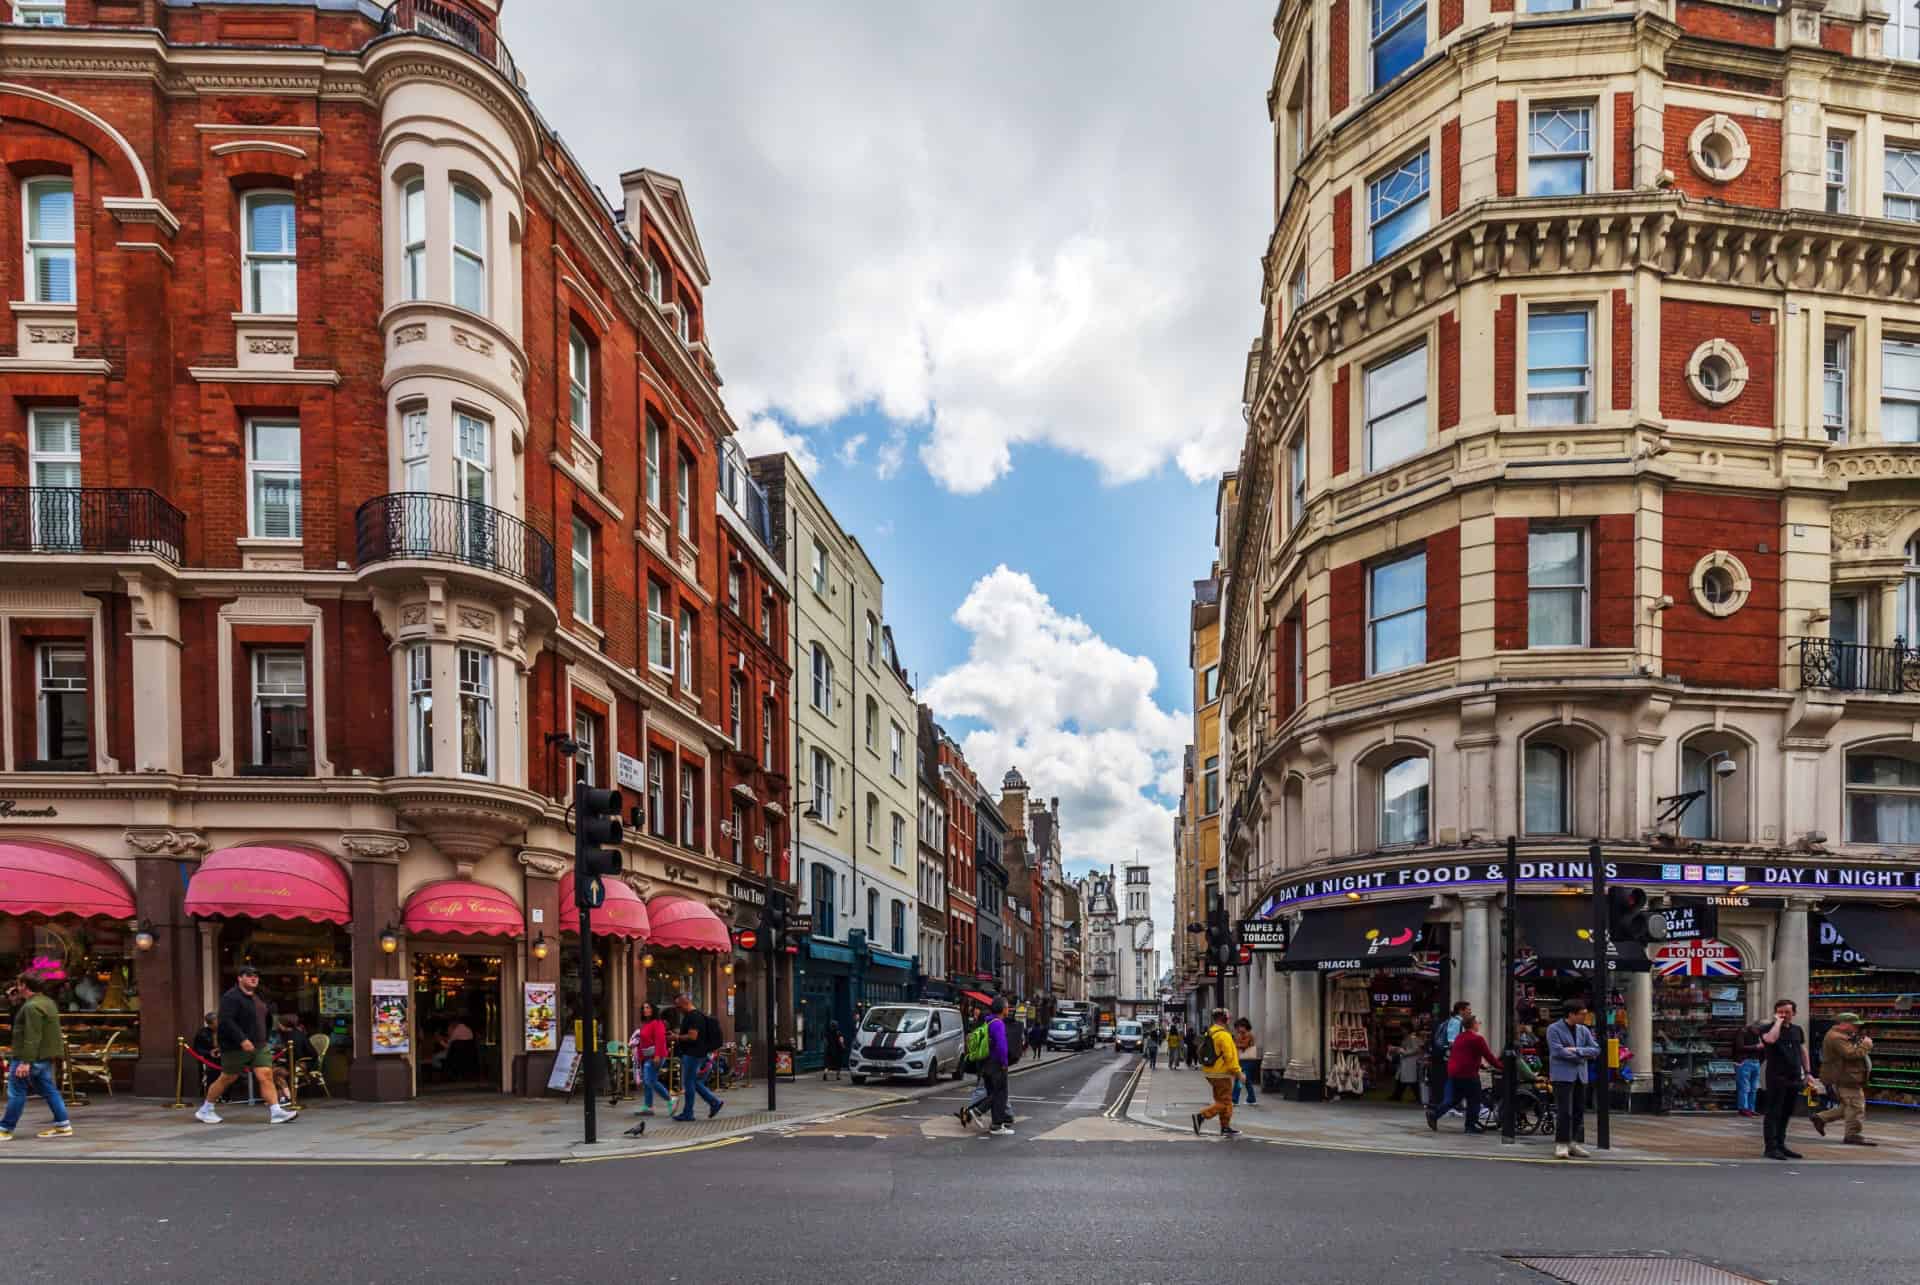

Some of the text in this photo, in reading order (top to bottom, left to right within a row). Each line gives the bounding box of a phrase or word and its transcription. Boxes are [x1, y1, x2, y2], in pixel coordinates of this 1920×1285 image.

[1764, 867, 1804, 884] DAY
[1815, 869, 1829, 884] N
[1840, 869, 1904, 887] NIGHT
[1280, 886, 1299, 902] DAY
[1305, 882, 1315, 897] N
[1322, 872, 1386, 893] NIGHT
[1399, 866, 1470, 885] FOOD
[1486, 864, 1504, 880] &
[1706, 896, 1750, 906] DRINKS
[1683, 908, 1693, 918] N
[1244, 923, 1283, 932] VAPES &
[1666, 919, 1695, 931] GHT
[1242, 933, 1285, 942] TOBACCO
[1668, 948, 1725, 958] LONDON
[1318, 960, 1361, 969] SNACKS
[1572, 960, 1616, 969] VAS
